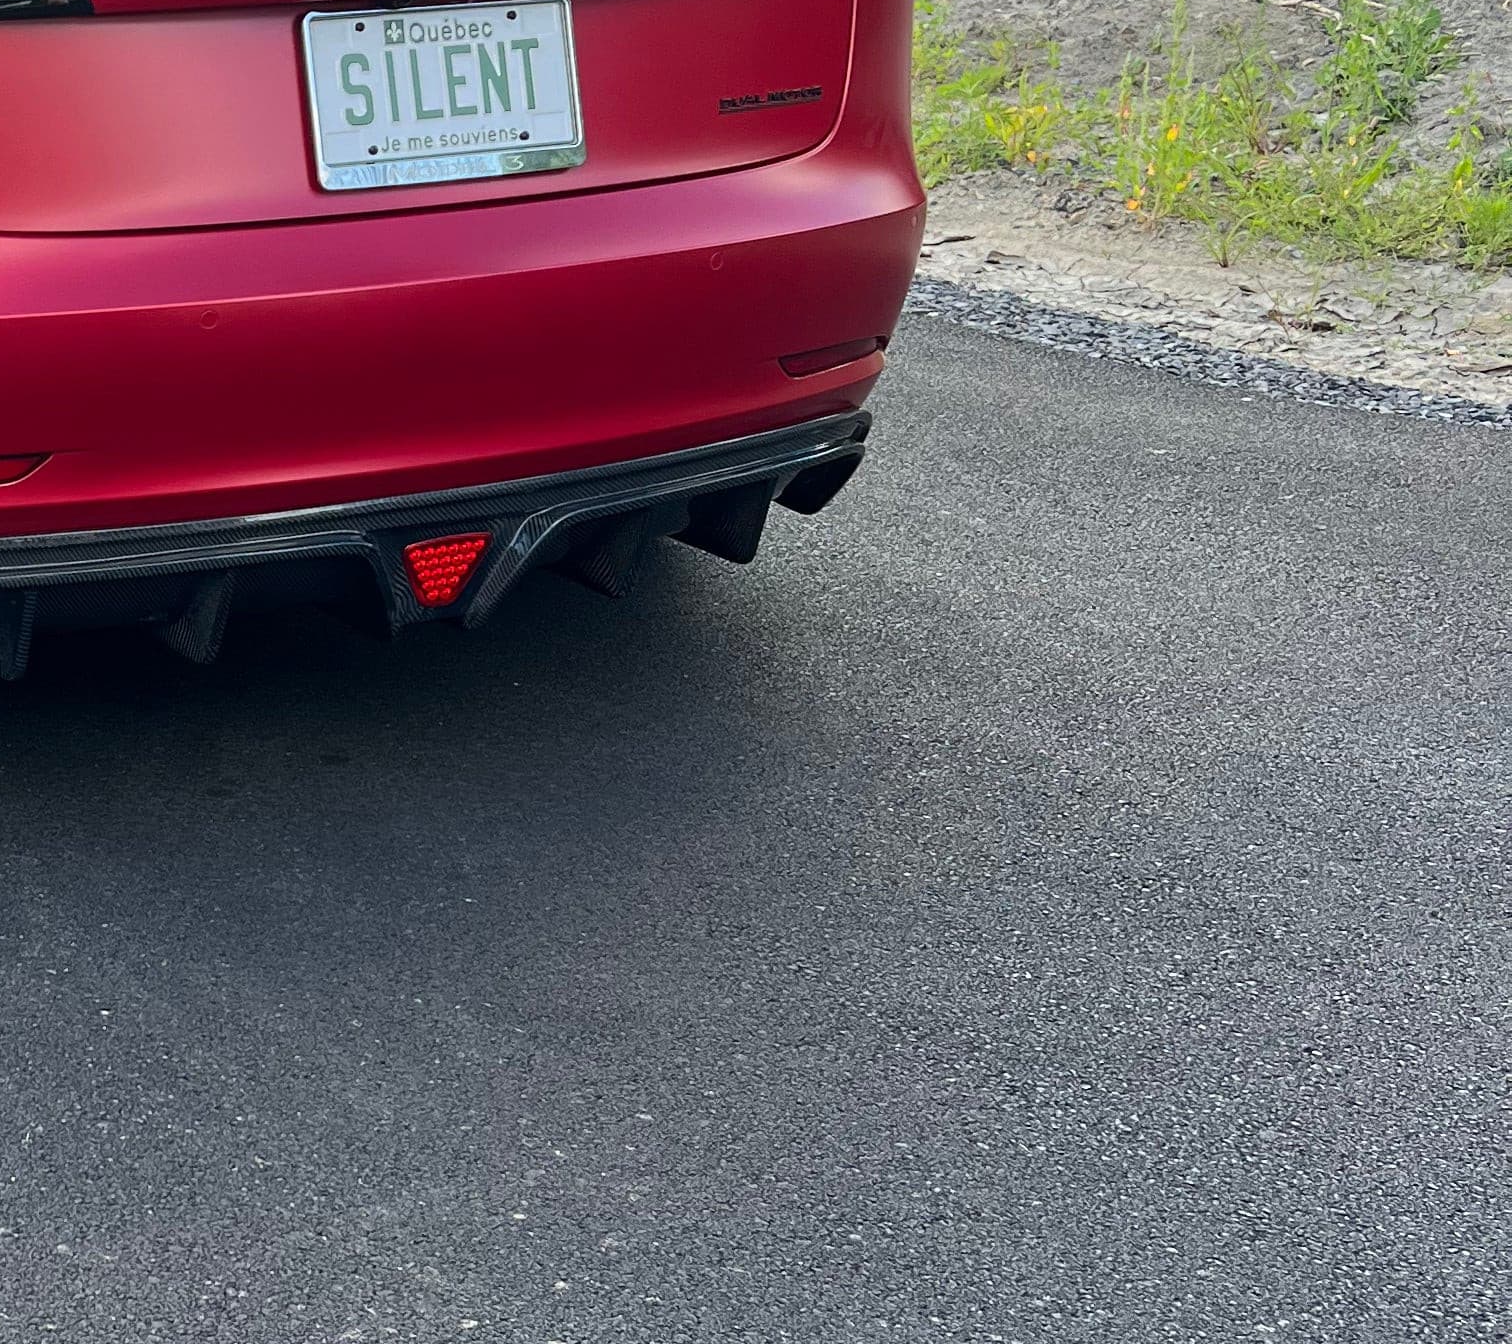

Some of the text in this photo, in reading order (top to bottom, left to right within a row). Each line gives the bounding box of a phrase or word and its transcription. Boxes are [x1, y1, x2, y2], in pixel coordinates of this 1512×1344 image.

[408, 18, 494, 43] Québec
[340, 38, 539, 126] SILENT
[381, 126, 519, 153] Je me souviens
[504, 155, 525, 171] 3
